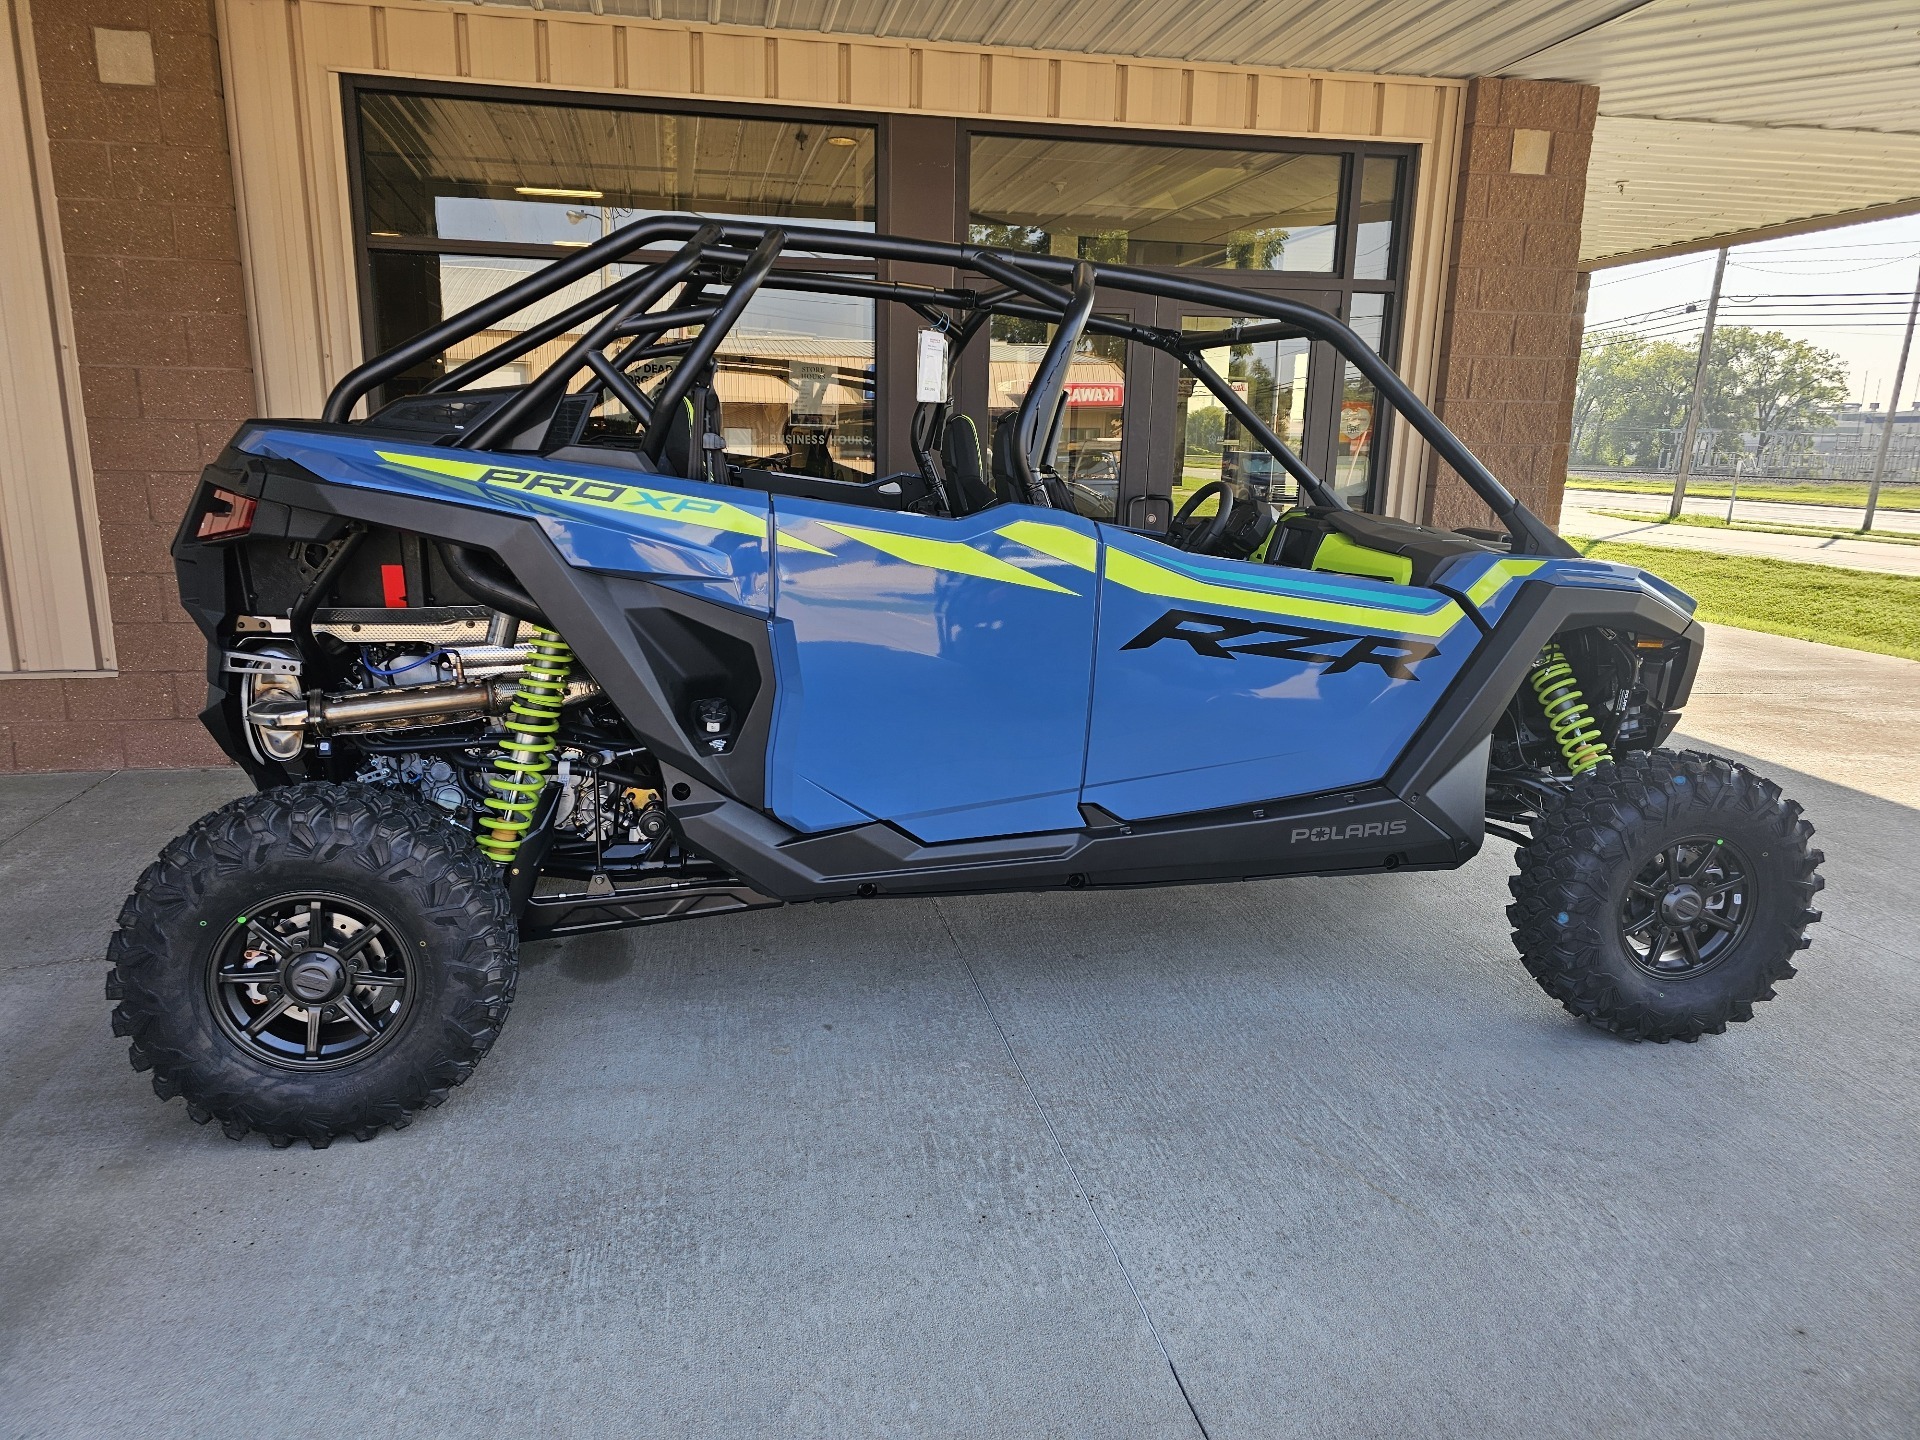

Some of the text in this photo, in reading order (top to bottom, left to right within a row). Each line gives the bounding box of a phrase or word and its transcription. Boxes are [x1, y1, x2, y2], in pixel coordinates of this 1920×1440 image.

[770, 434, 870, 445] BUSINESS HOURS
[478, 468, 722, 514] PRO XP
[1118, 608, 1442, 682] RZR
[1290, 820, 1407, 844] POLARIS
